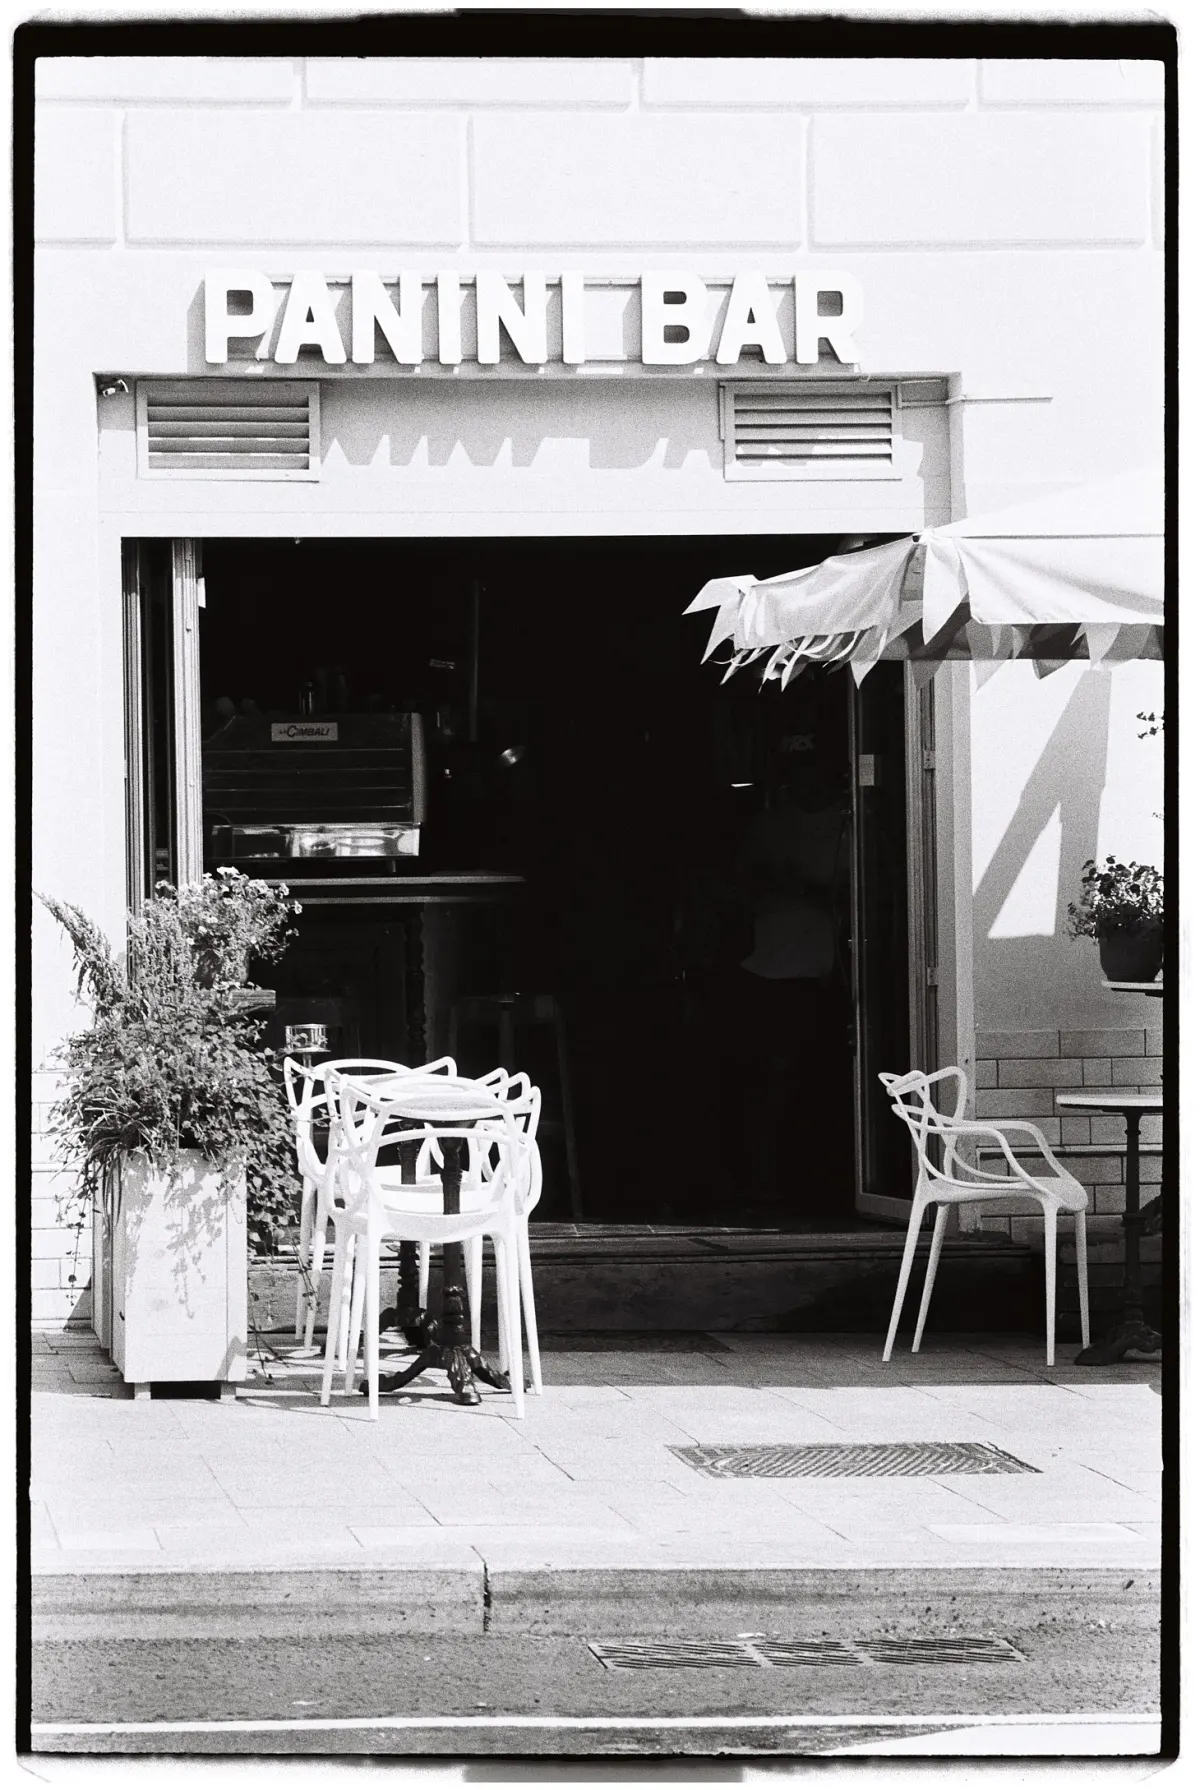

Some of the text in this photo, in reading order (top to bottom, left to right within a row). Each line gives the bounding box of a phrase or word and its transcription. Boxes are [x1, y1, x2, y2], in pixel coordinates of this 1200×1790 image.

[204, 270, 864, 365] PANINI BAR
[287, 725, 330, 738] CIMBALI
